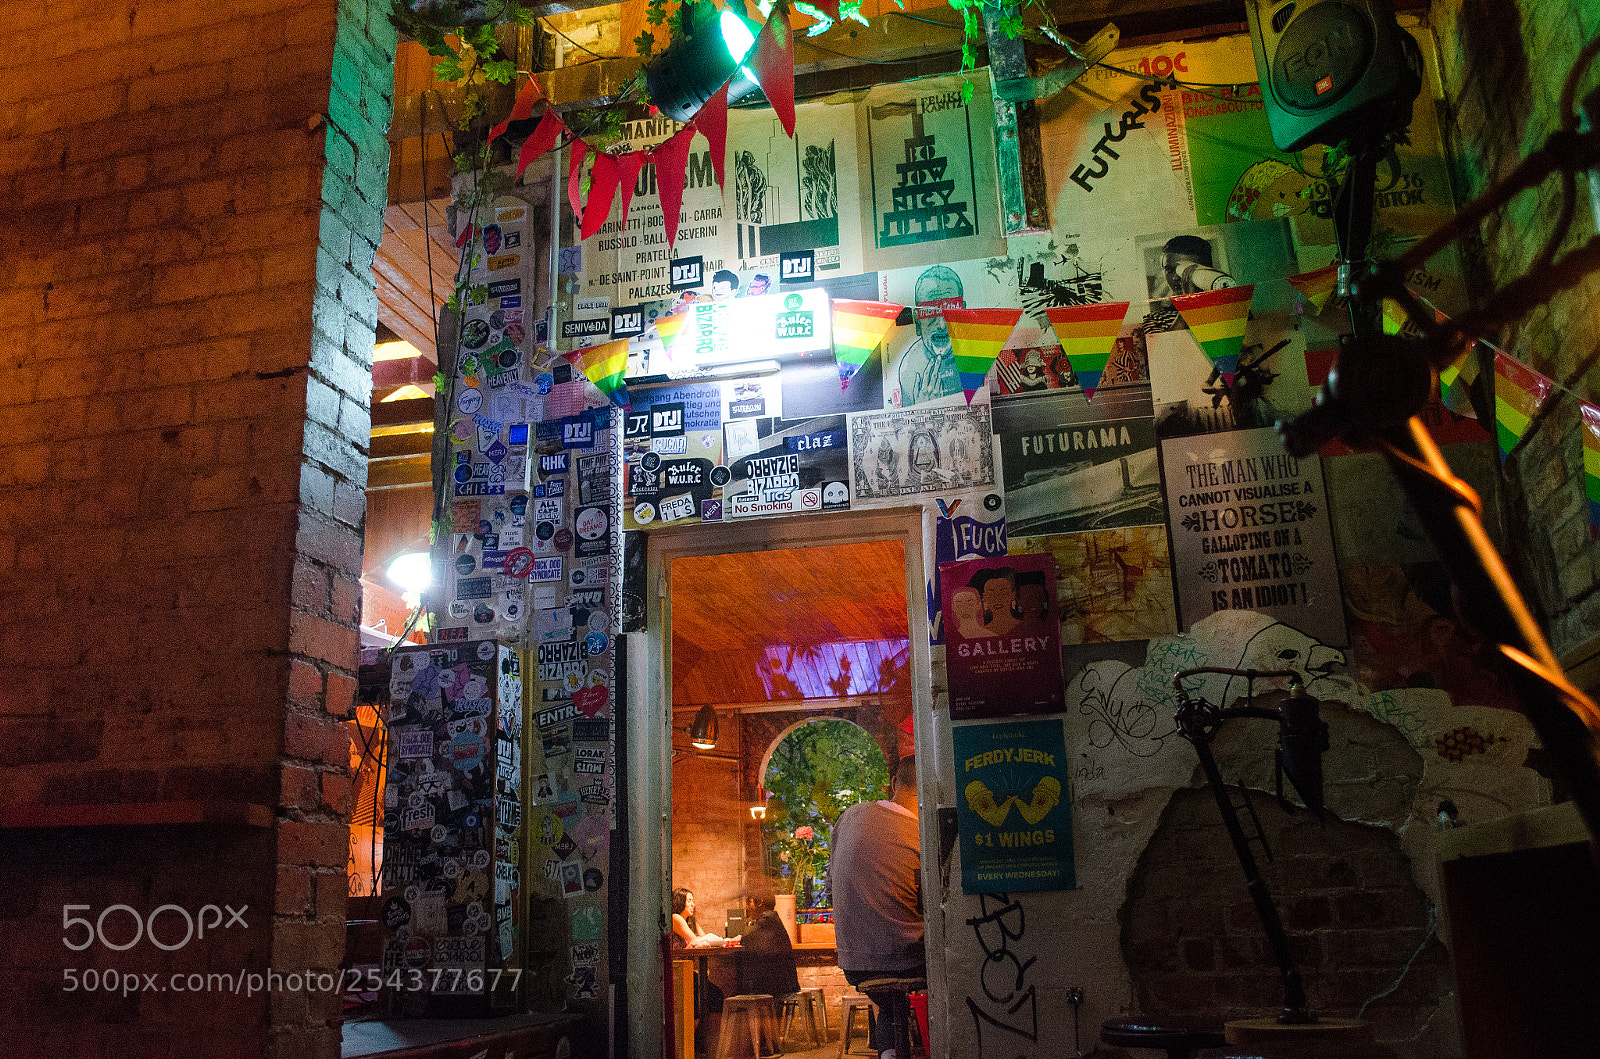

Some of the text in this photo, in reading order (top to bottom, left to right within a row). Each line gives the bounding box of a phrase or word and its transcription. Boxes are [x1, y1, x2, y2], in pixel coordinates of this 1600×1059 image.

[677, 225, 718, 242] SEVERINI
[635, 247, 679, 265] PRATELLA
[671, 262, 701, 282] DTJ!
[783, 257, 812, 275] DTJ!
[599, 274, 610, 286] DE
[613, 311, 642, 331] DTJ!
[672, 388, 721, 401] Abendroth
[705, 399, 721, 408] und
[653, 410, 682, 428] DTJ!
[563, 422, 592, 440] DTJ!
[1021, 426, 1131, 456] FUTURAMA
[1186, 453, 1299, 489] THE MAN WHO
[1178, 481, 1313, 508] CANNOT VISUALISE A
[660, 497, 690, 515] FREDA
[734, 501, 793, 517] No Smoking
[1200, 500, 1296, 532] HORSE
[960, 522, 1007, 552] FUCK
[1201, 528, 1303, 555] GALLOPING ON A
[1217, 552, 1293, 584] TOMATO
[1211, 589, 1228, 612] IS
[1231, 586, 1254, 610] AN
[957, 636, 1050, 658] GALLERY
[964, 747, 1056, 773] FERDY JERK
[974, 829, 1056, 848] $1 WINGS
[977, 869, 1061, 881] EVERY WEDNESDAY!
